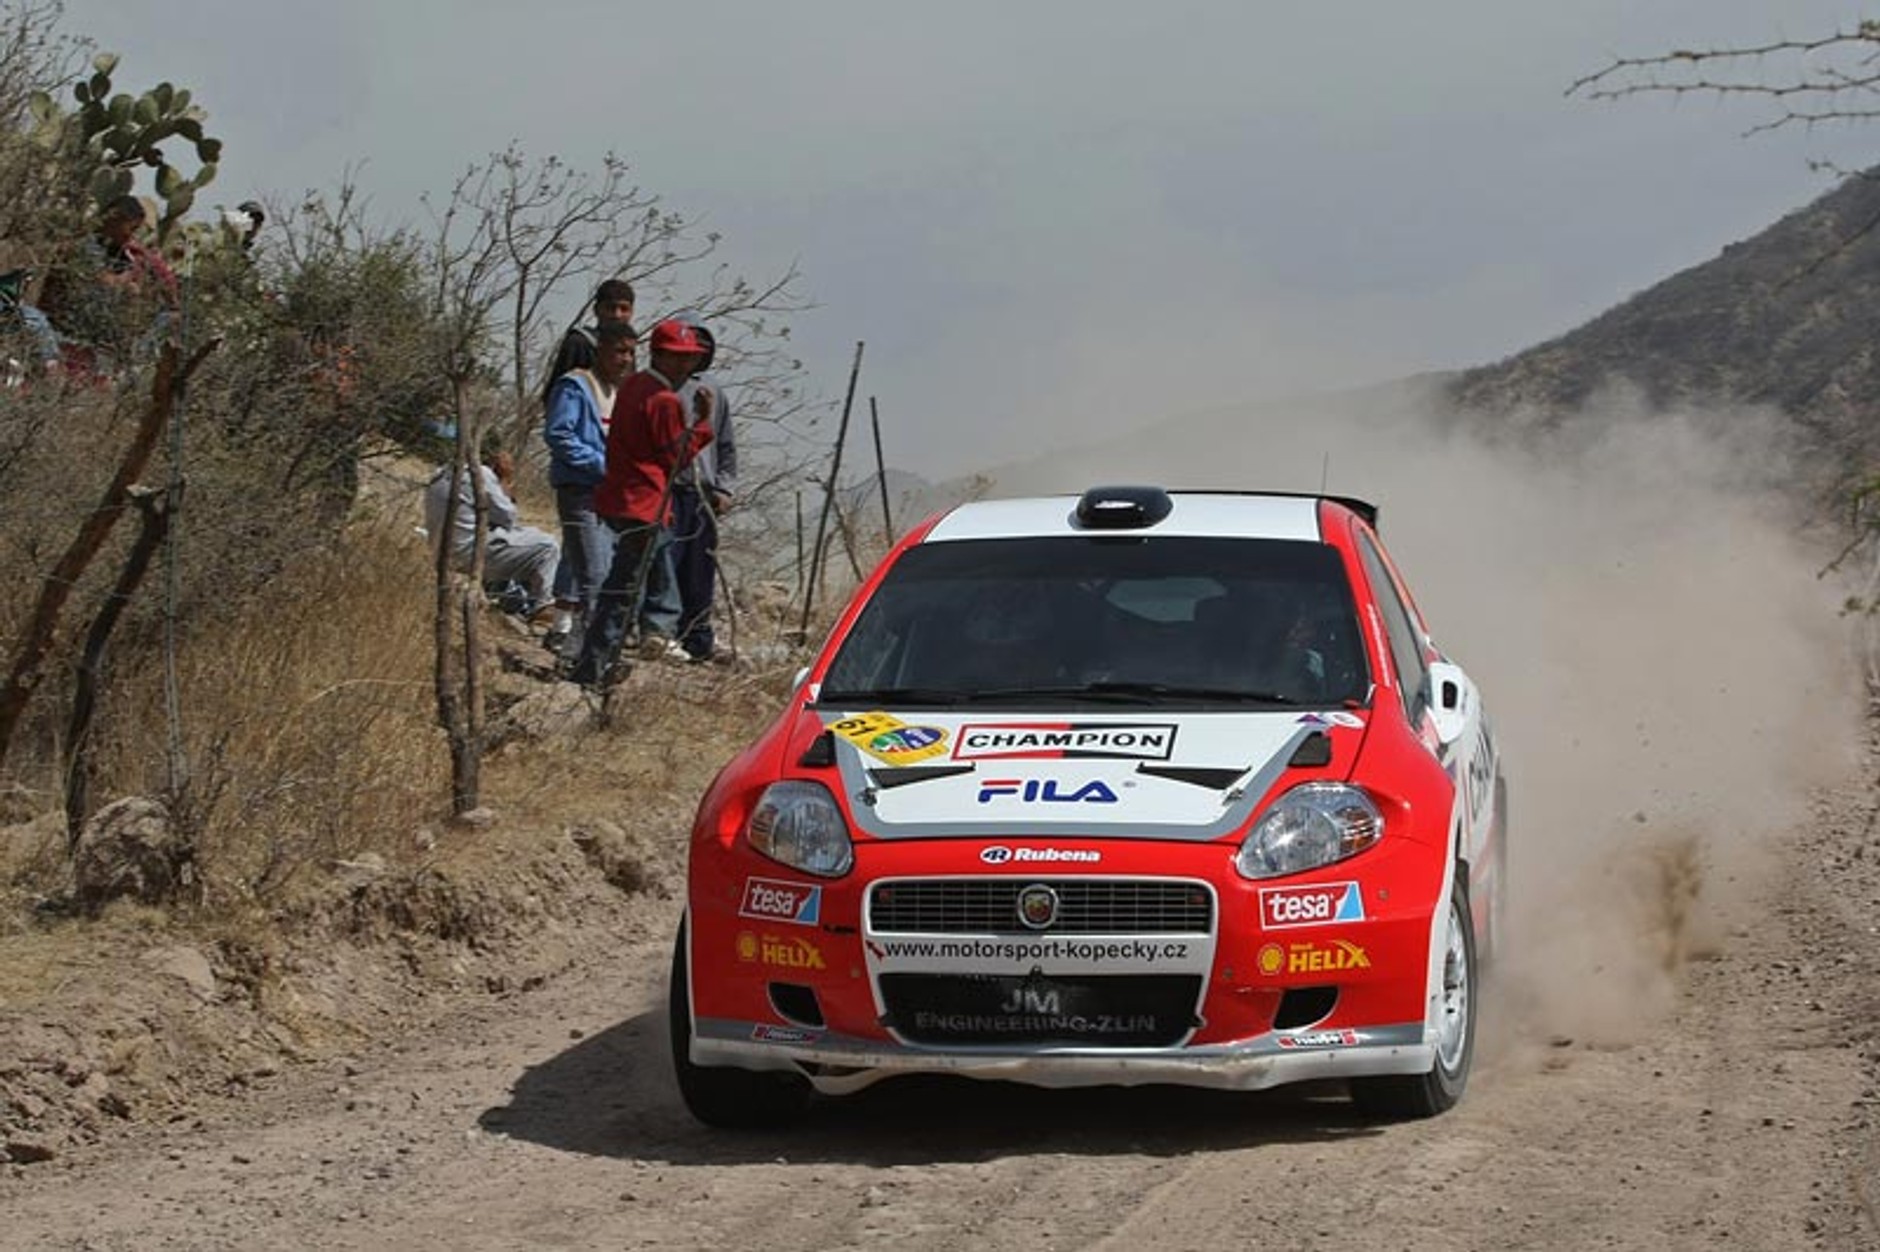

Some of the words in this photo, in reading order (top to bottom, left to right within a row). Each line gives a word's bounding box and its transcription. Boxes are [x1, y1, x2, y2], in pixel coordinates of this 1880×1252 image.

[966, 732, 1164, 748] CHAMPION
[977, 779, 1120, 803] FILA
[1013, 847, 1102, 862] Rubena
[751, 884, 796, 915] tesa
[1267, 893, 1331, 921] tesa
[761, 939, 827, 970] HELIX
[884, 939, 1188, 963] www.motorsport-kopecky.cz
[1288, 940, 1371, 973] HELIX
[1000, 988, 1061, 1015] JM
